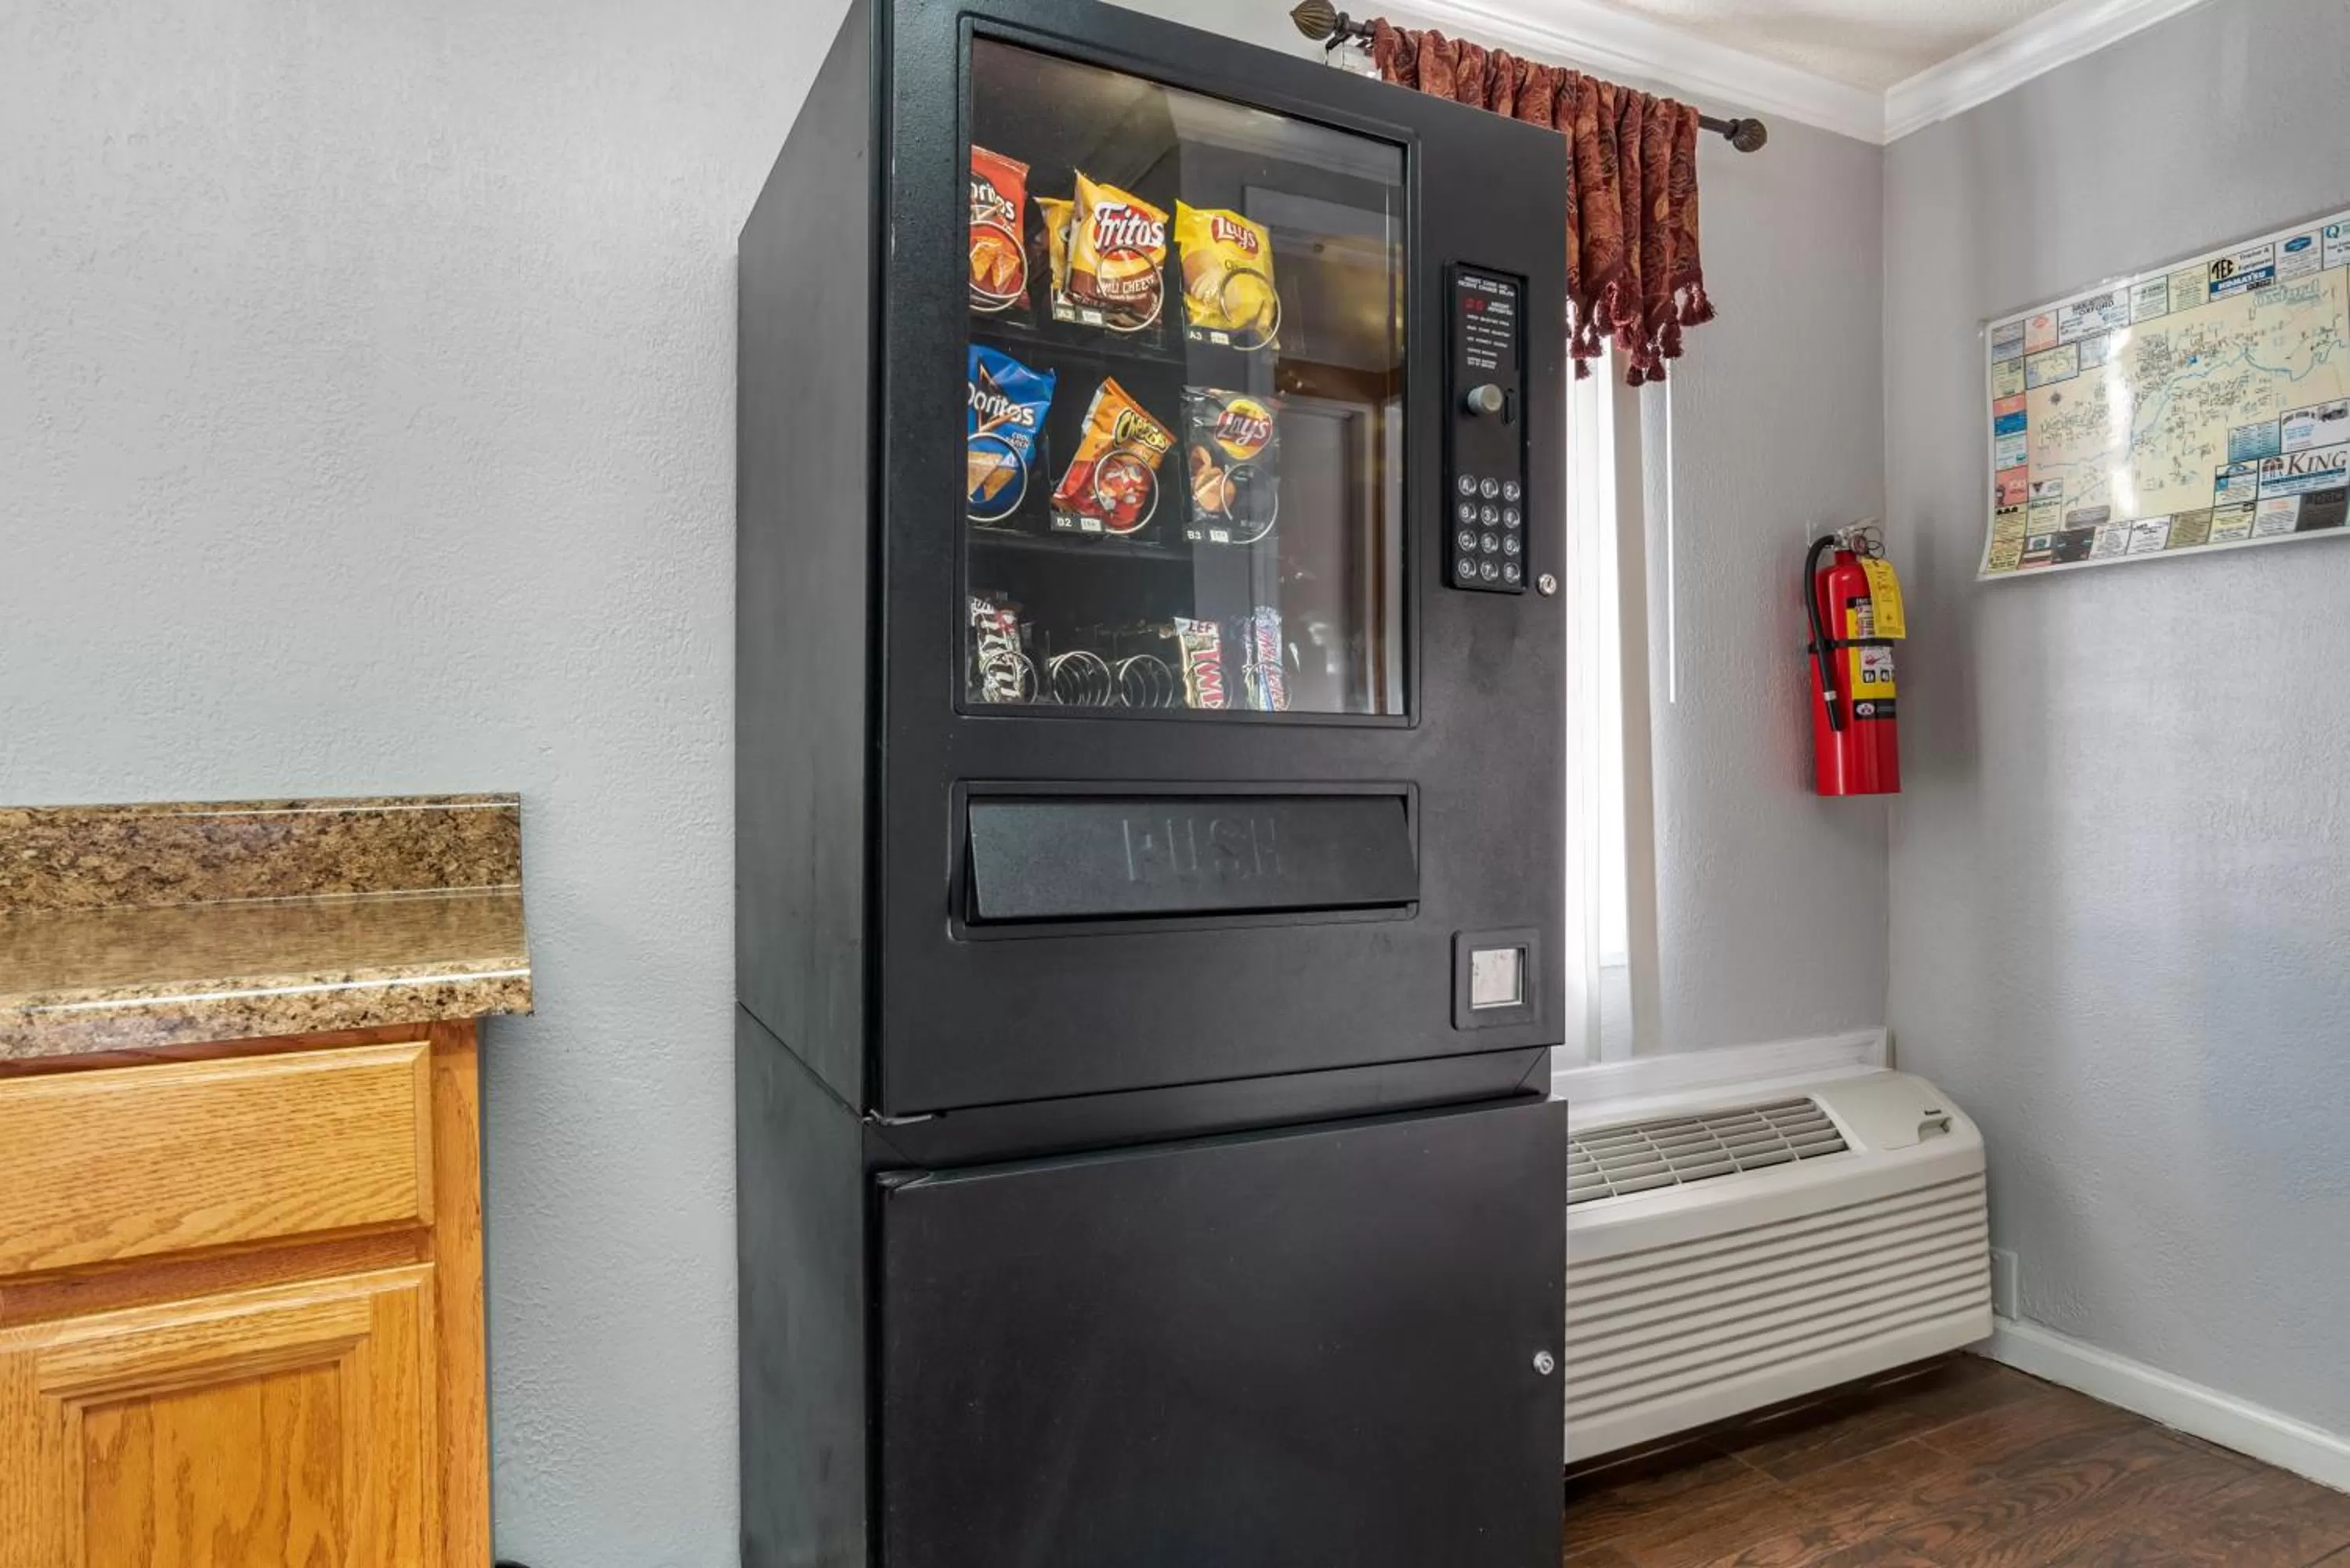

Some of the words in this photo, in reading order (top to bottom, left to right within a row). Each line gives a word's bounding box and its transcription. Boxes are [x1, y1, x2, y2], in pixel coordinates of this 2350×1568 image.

[1094, 201, 1166, 250] Fritos
[1217, 413, 1269, 446] Lay's
[2287, 450, 2348, 475] KING
